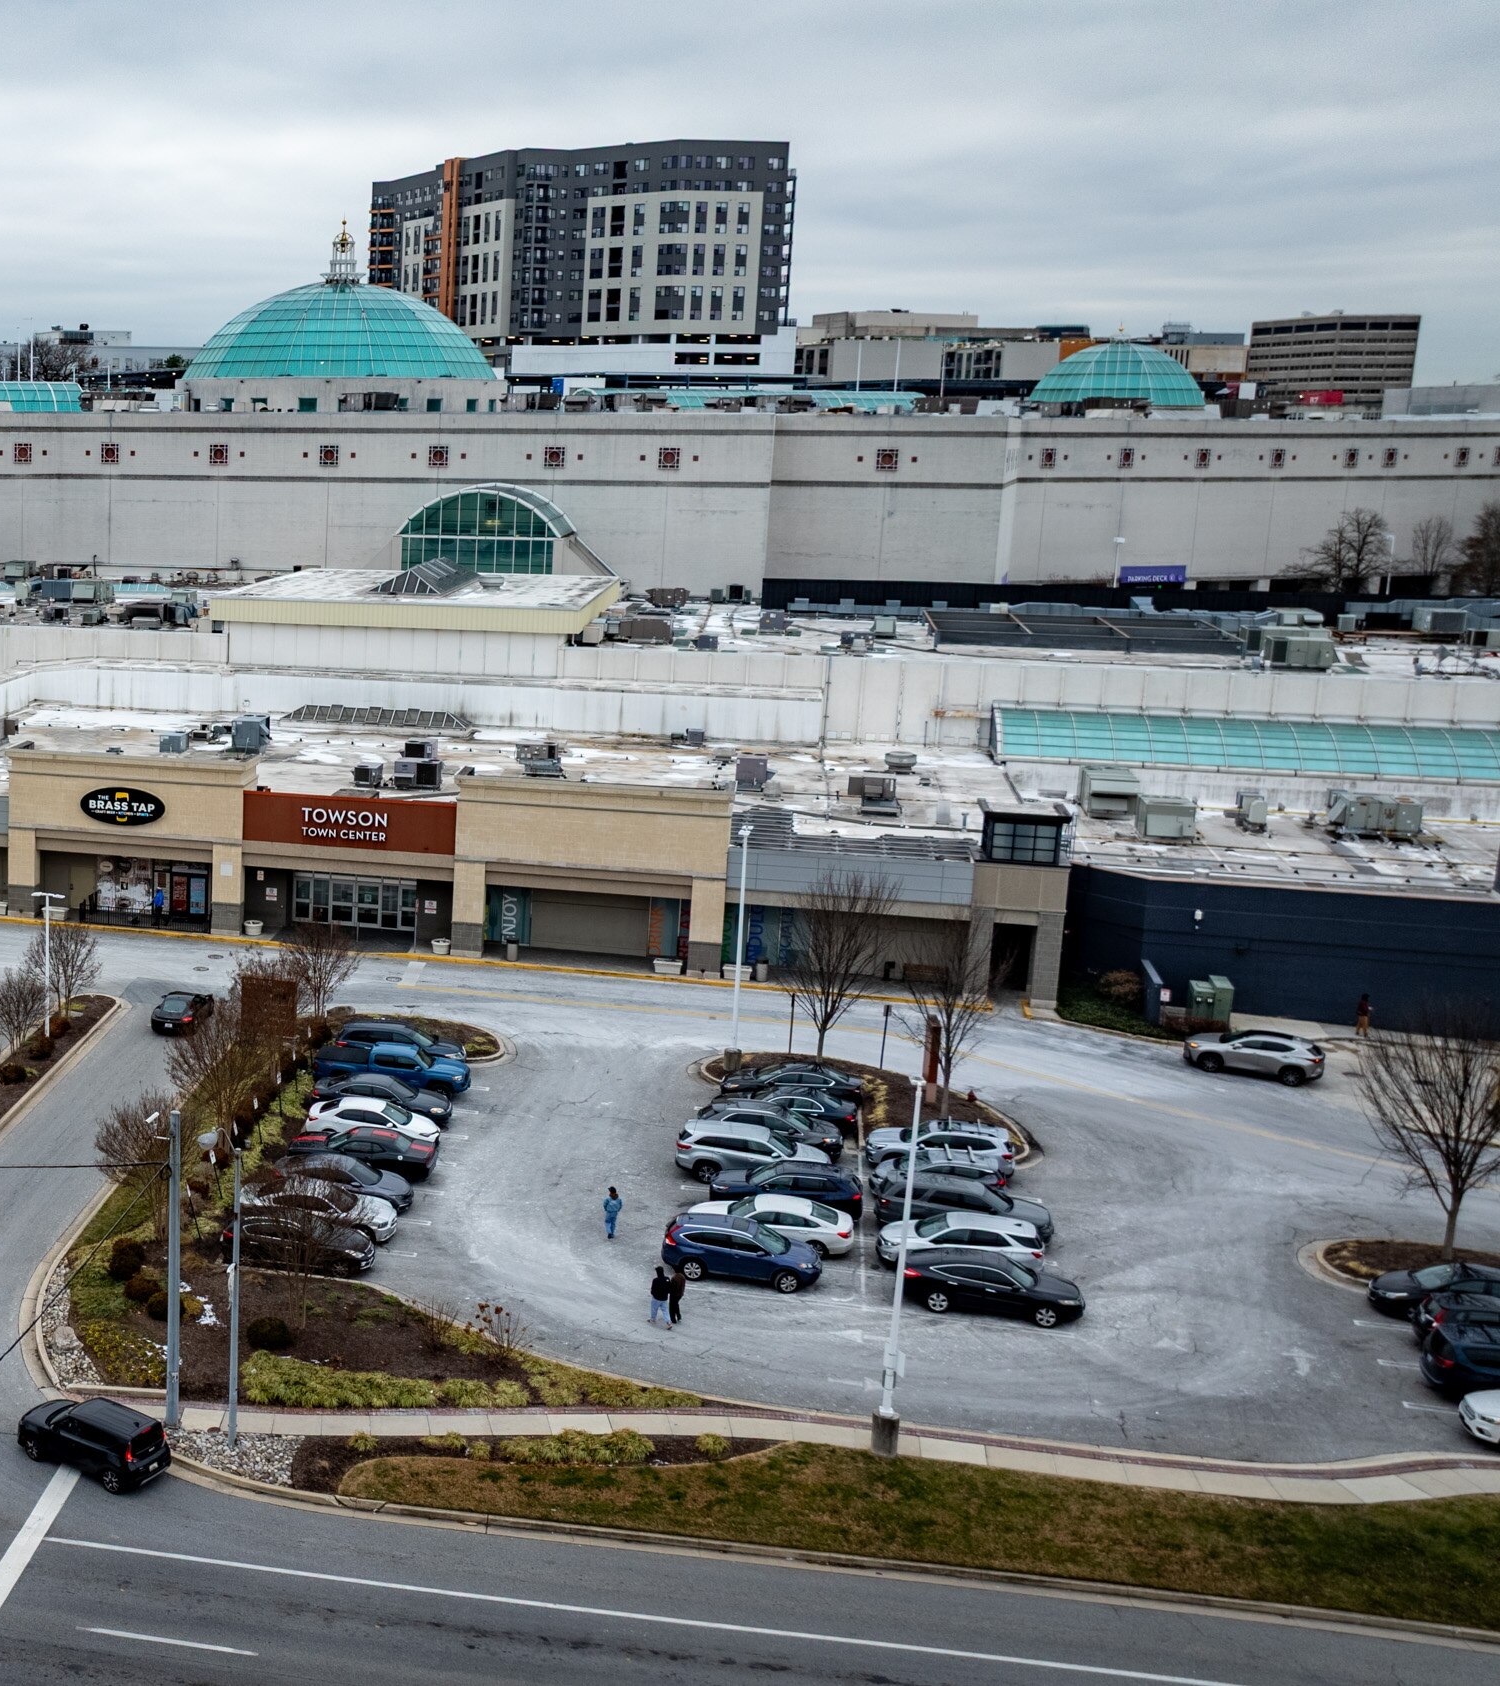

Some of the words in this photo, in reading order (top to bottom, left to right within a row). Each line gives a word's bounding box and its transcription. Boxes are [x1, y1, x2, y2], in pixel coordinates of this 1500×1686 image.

[1127, 575, 1152, 583] PARKING
[1152, 575, 1168, 583] DECK
[89, 800, 128, 811] BRASS
[131, 803, 155, 813] TAP
[301, 807, 388, 828] TOWSON
[301, 827, 337, 838] TOWN
[340, 829, 386, 842] CENTER
[649, 906, 664, 956] DRINK
